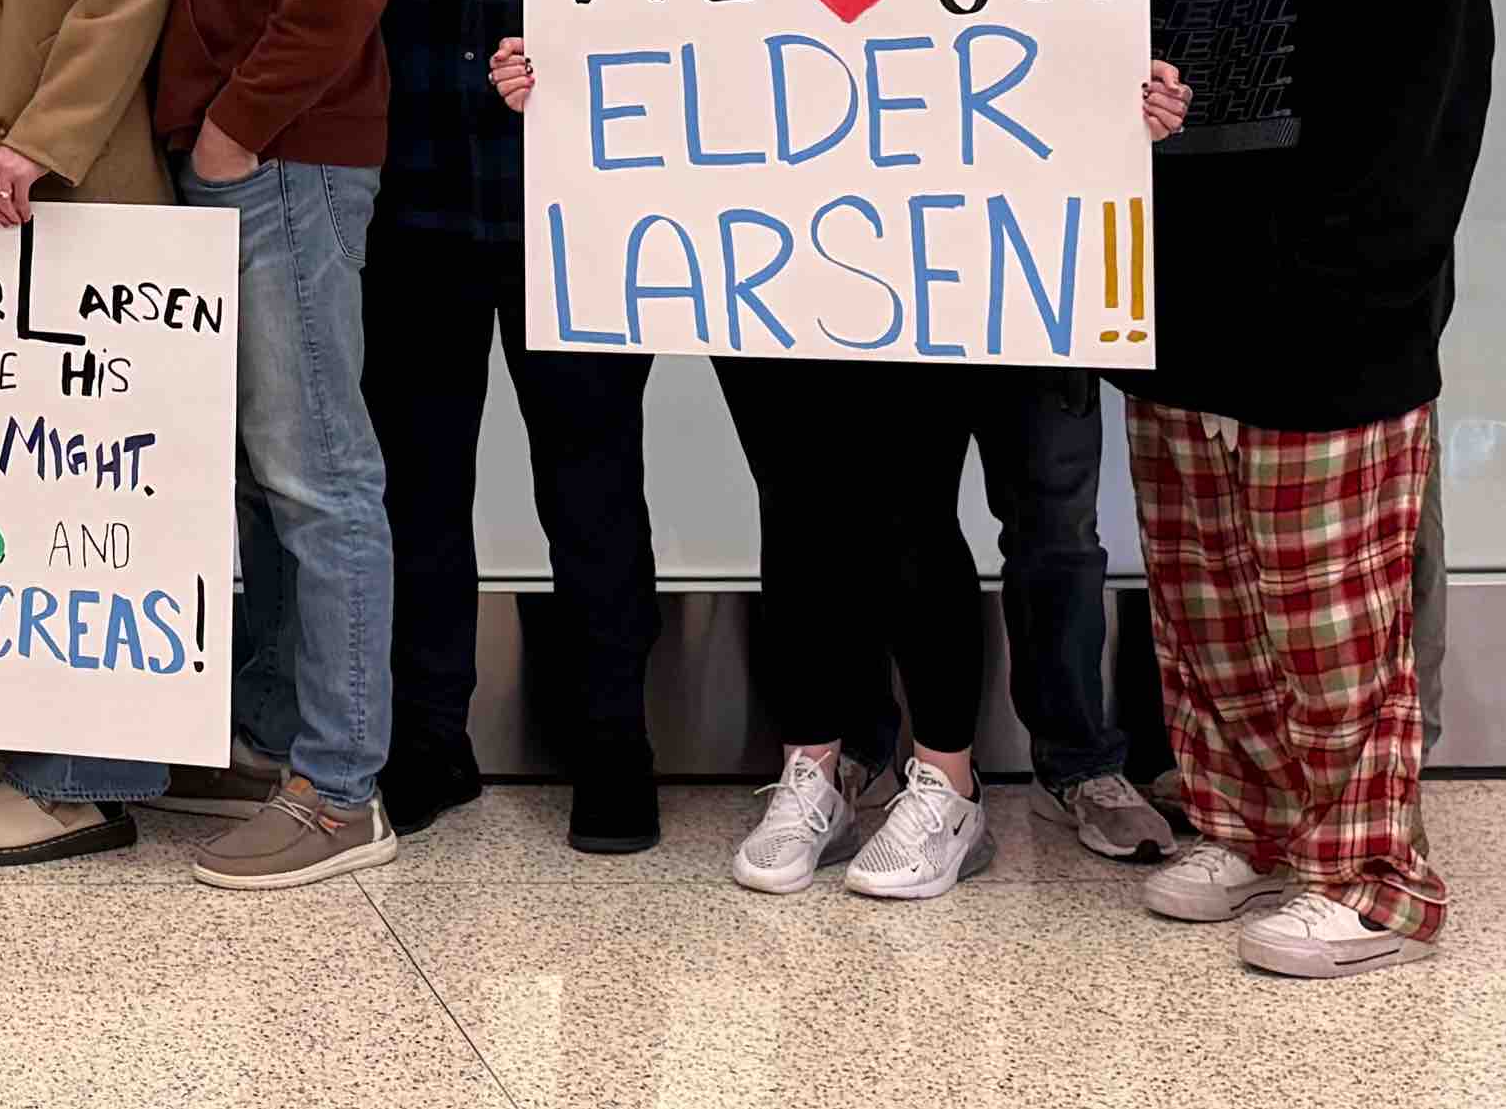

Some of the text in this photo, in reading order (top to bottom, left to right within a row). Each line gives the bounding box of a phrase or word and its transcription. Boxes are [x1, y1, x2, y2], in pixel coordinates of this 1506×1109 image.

[588, 24, 1053, 170] ELDER
[16, 213, 224, 346] LARSEN
[547, 195, 1149, 358] LARSEN!!
[48, 521, 131, 569] AND
